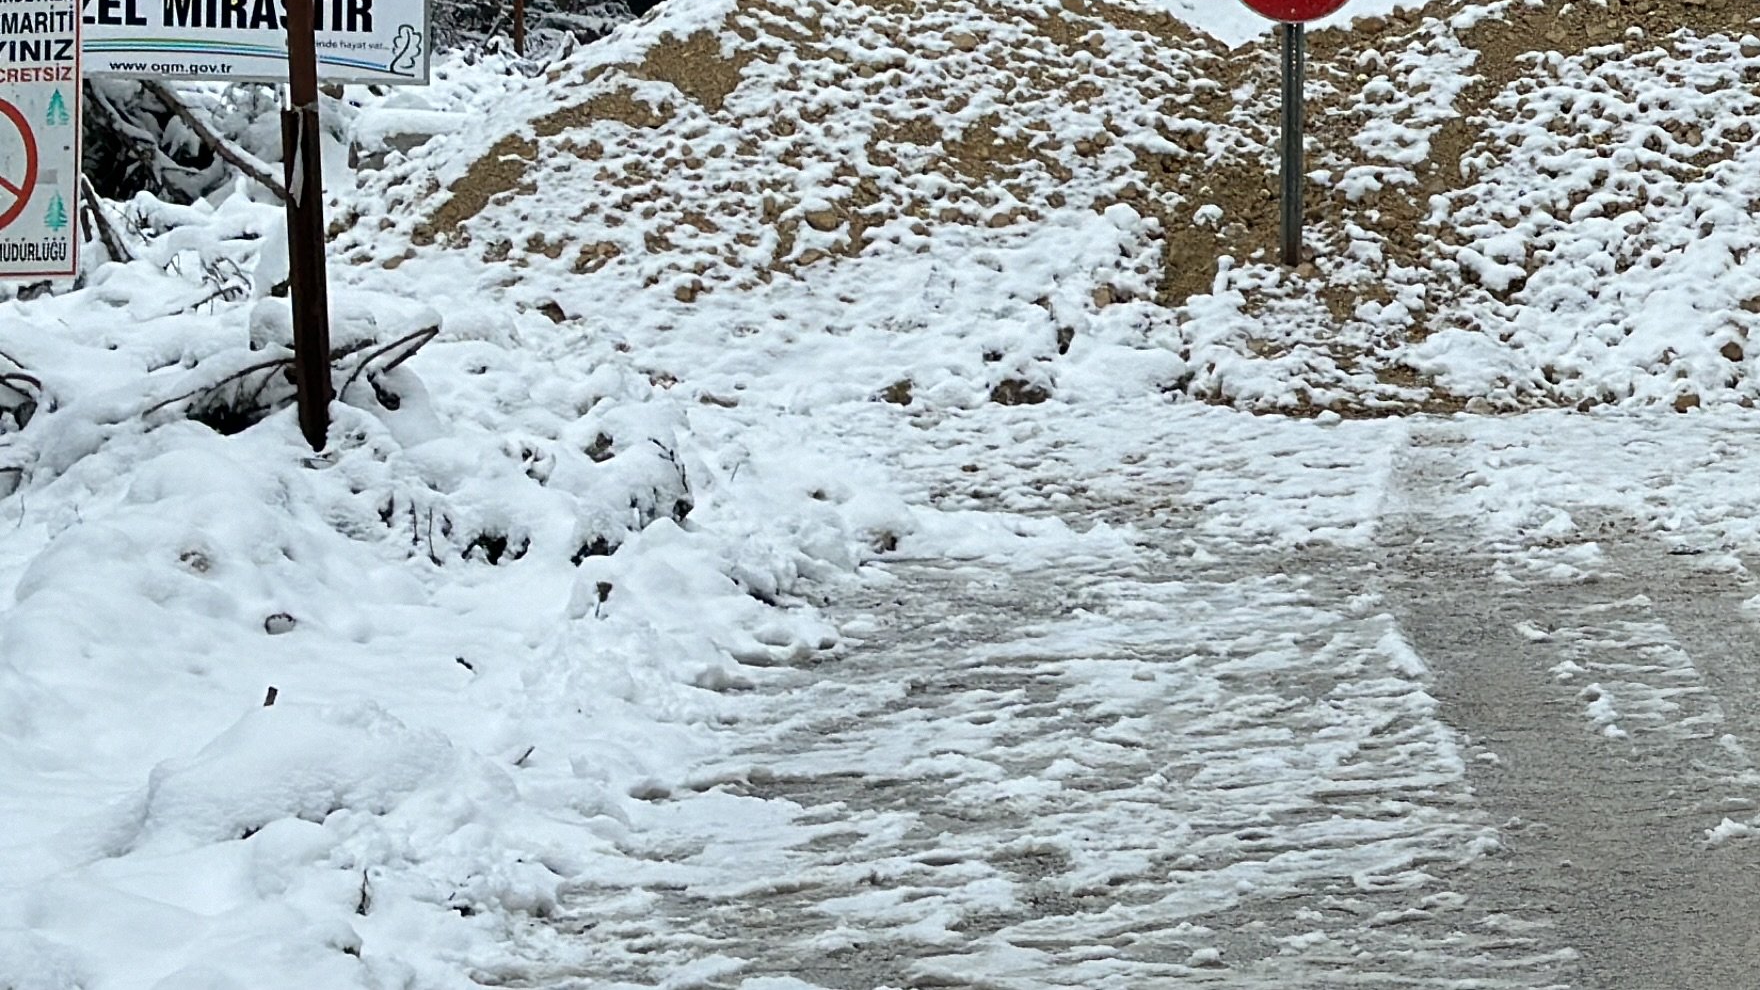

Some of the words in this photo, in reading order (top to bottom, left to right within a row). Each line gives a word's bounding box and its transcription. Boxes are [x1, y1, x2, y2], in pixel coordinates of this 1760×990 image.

[1, 4, 74, 35] MARİTİ
[109, 61, 233, 74] wwwogm.gov.tr
[0, 236, 67, 262] ÜDÜRLÜĞÜ
